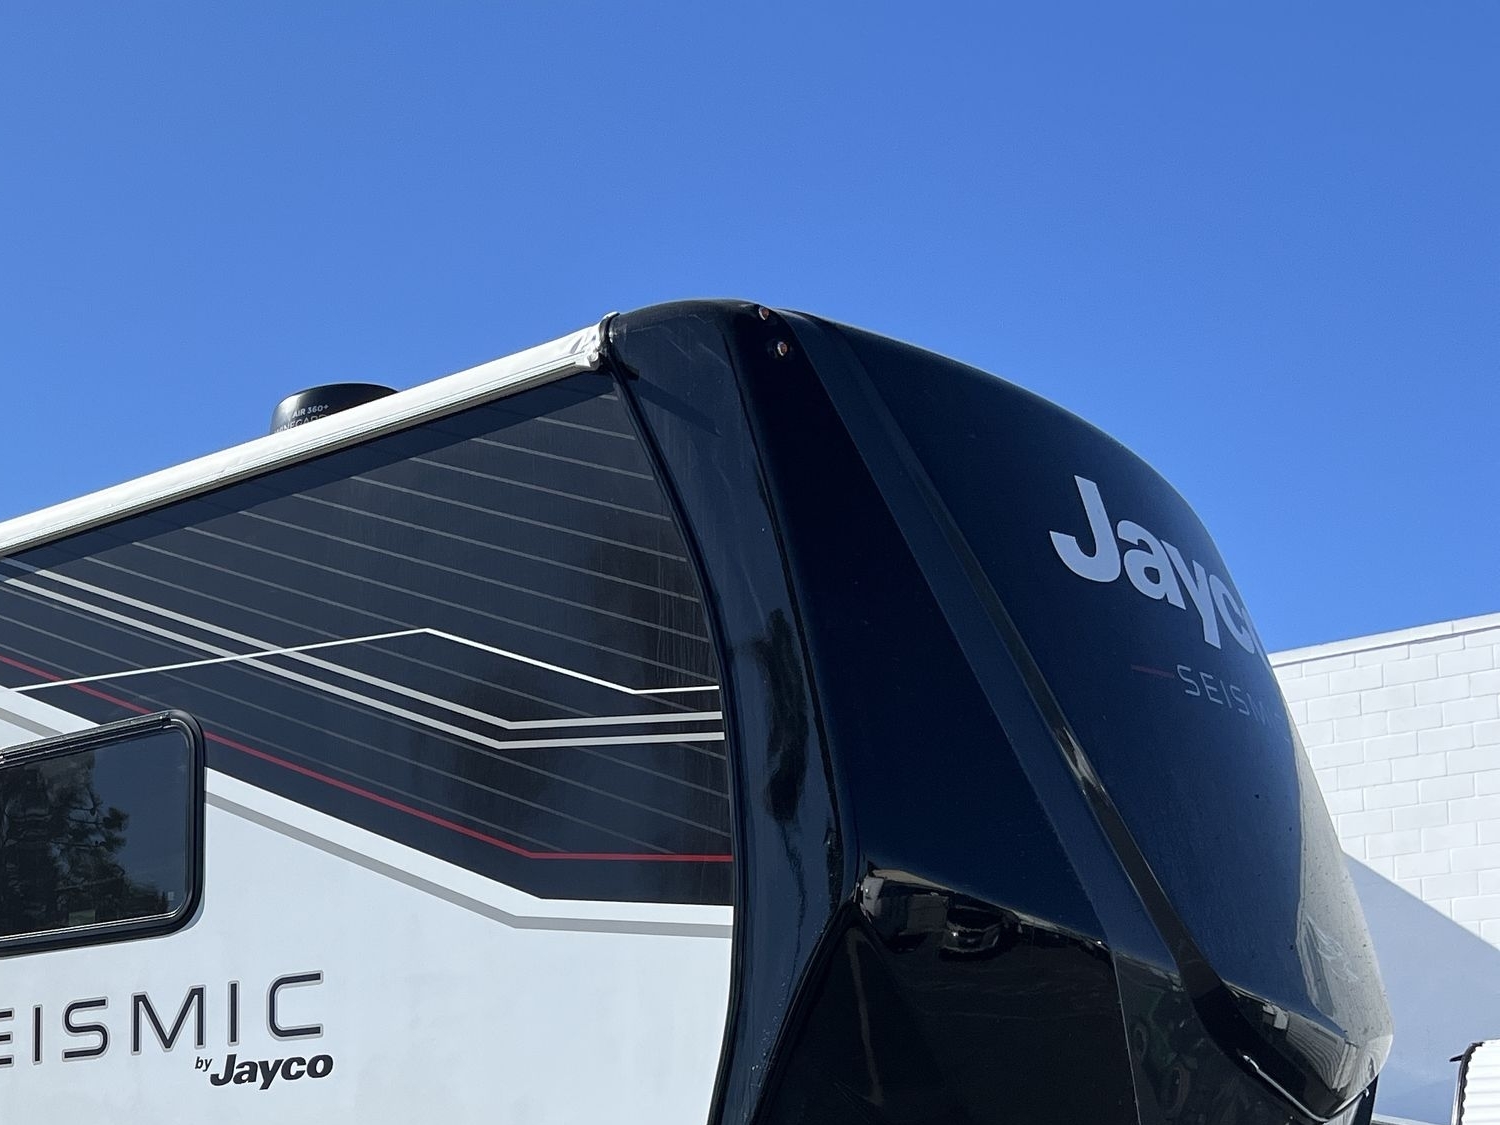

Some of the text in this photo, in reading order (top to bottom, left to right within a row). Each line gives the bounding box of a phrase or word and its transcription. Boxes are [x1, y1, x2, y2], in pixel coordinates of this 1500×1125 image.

[292, 409, 306, 419] AIR
[1050, 475, 1270, 670] Jayc
[1176, 664, 1282, 731] SEISM
[194, 1053, 334, 1090] by Jayco
